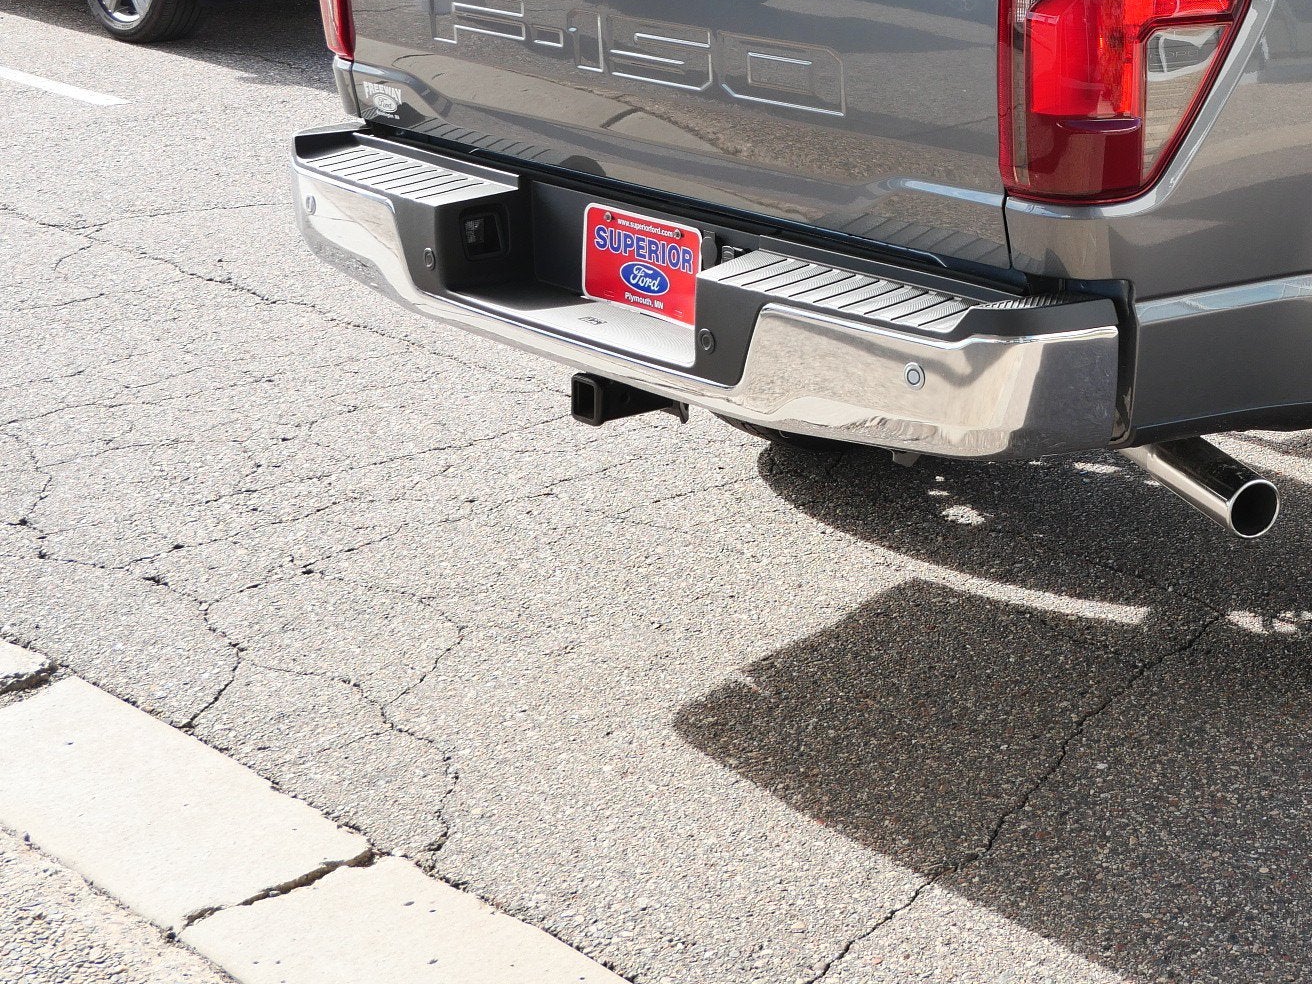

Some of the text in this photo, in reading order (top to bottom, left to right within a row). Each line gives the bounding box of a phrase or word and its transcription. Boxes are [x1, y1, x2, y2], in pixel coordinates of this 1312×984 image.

[594, 225, 694, 274] SUPERIOR
[629, 265, 661, 291] Ford
[624, 292, 664, 310] Plymouth, MN
